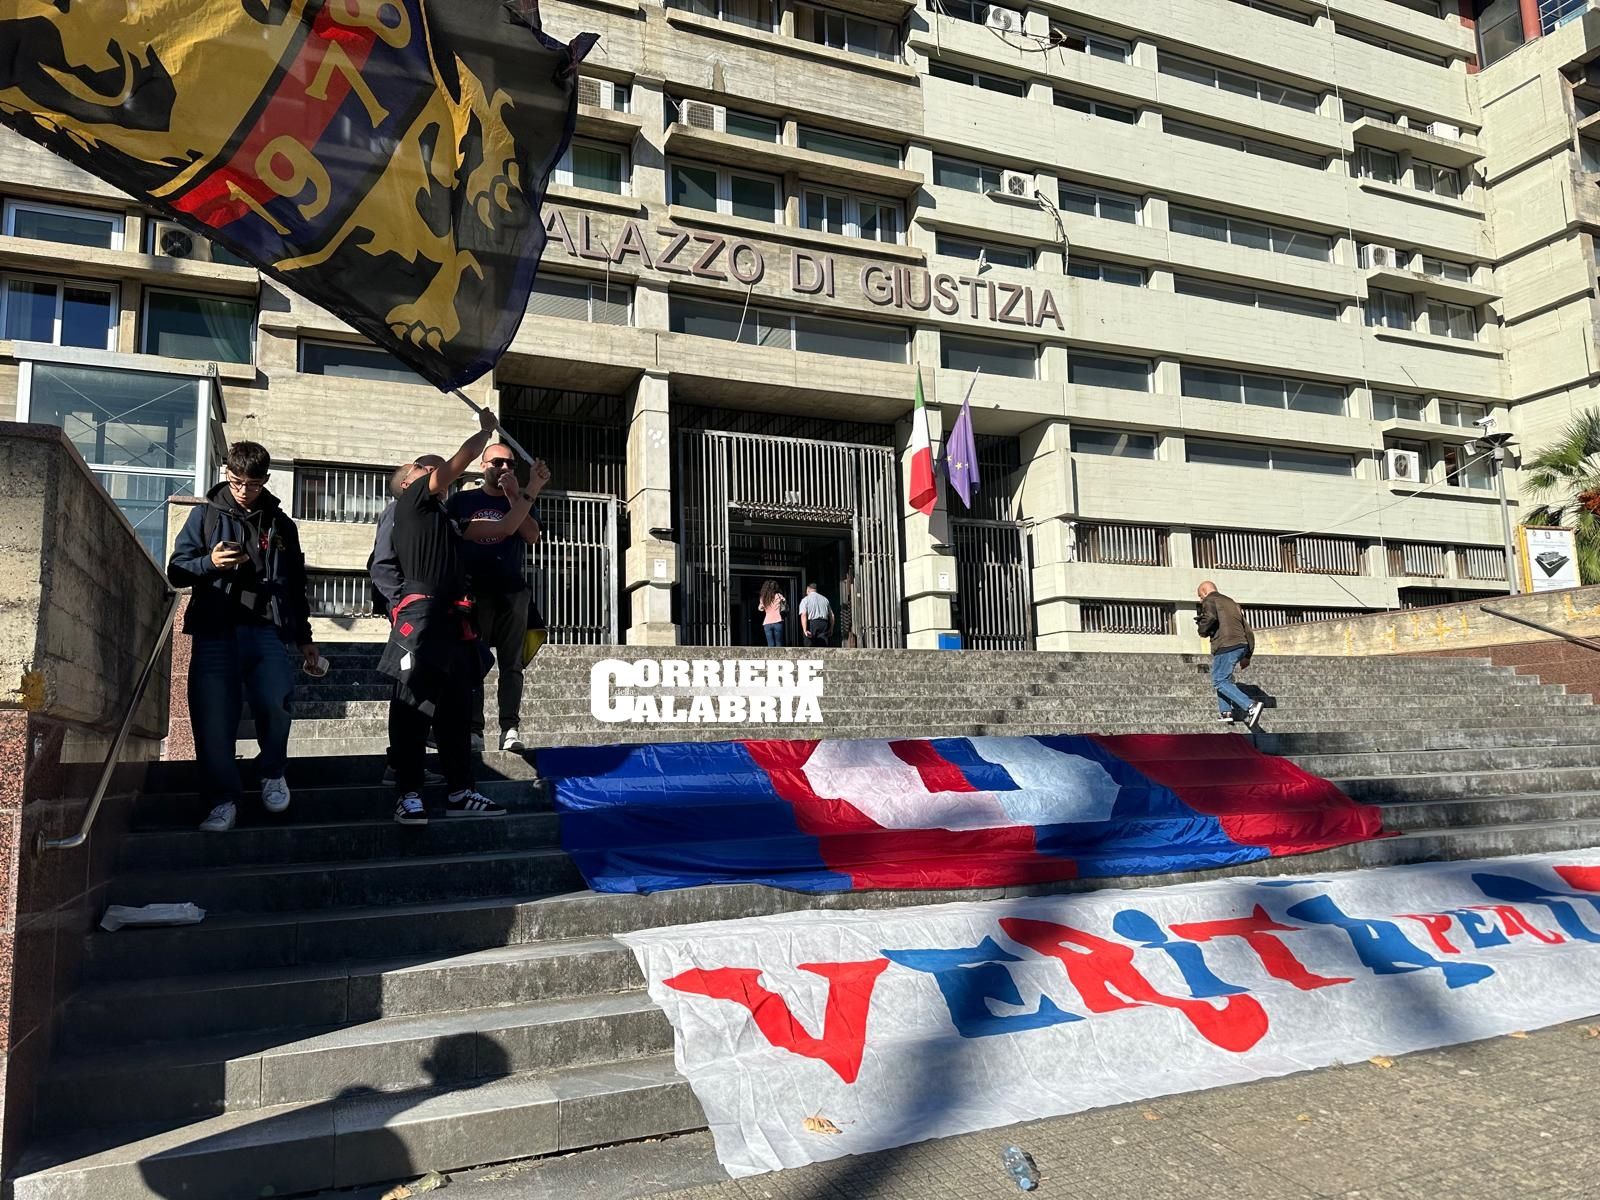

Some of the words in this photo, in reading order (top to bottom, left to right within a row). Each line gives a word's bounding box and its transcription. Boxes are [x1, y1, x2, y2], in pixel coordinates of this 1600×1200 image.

[538, 205, 765, 285] ALAZZO
[790, 249, 835, 298] DI
[860, 262, 1065, 331] GIUSTIZIA
